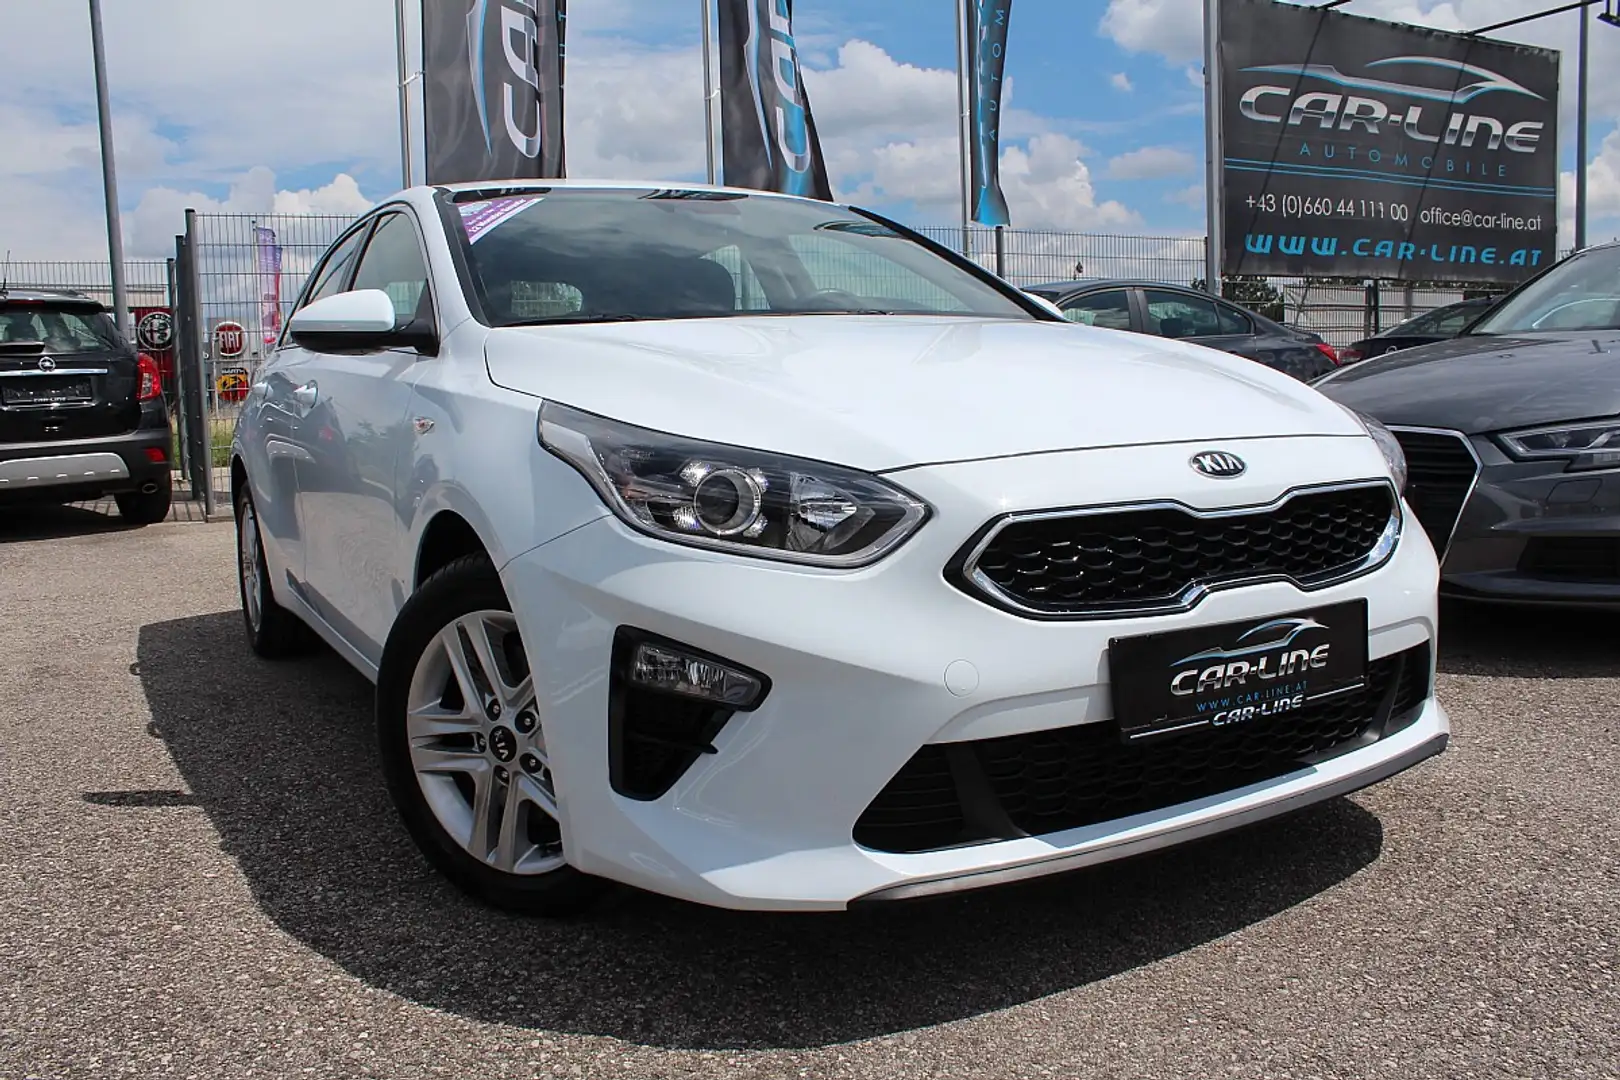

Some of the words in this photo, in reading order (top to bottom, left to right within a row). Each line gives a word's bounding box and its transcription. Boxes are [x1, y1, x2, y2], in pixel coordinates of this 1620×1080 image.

[501, 0, 541, 159] CA
[1239, 85, 1545, 154] CAR-LINE
[1299, 141, 1507, 178] AUTOMOBILE
[1246, 193, 1276, 213] +43
[1281, 194, 1333, 219] (0)660
[1336, 198, 1356, 217] 44
[1360, 199, 1385, 219] 111
[1390, 202, 1409, 222] 00
[1420, 206, 1542, 231] office@car-line.at
[220, 331, 241, 351] FIAT
[1195, 453, 1243, 473] KIA
[1170, 643, 1330, 697] CAR-LINE
[1196, 680, 1307, 713] WWW.CAR-LINE.AT
[1212, 694, 1304, 727] CAR-LINE
